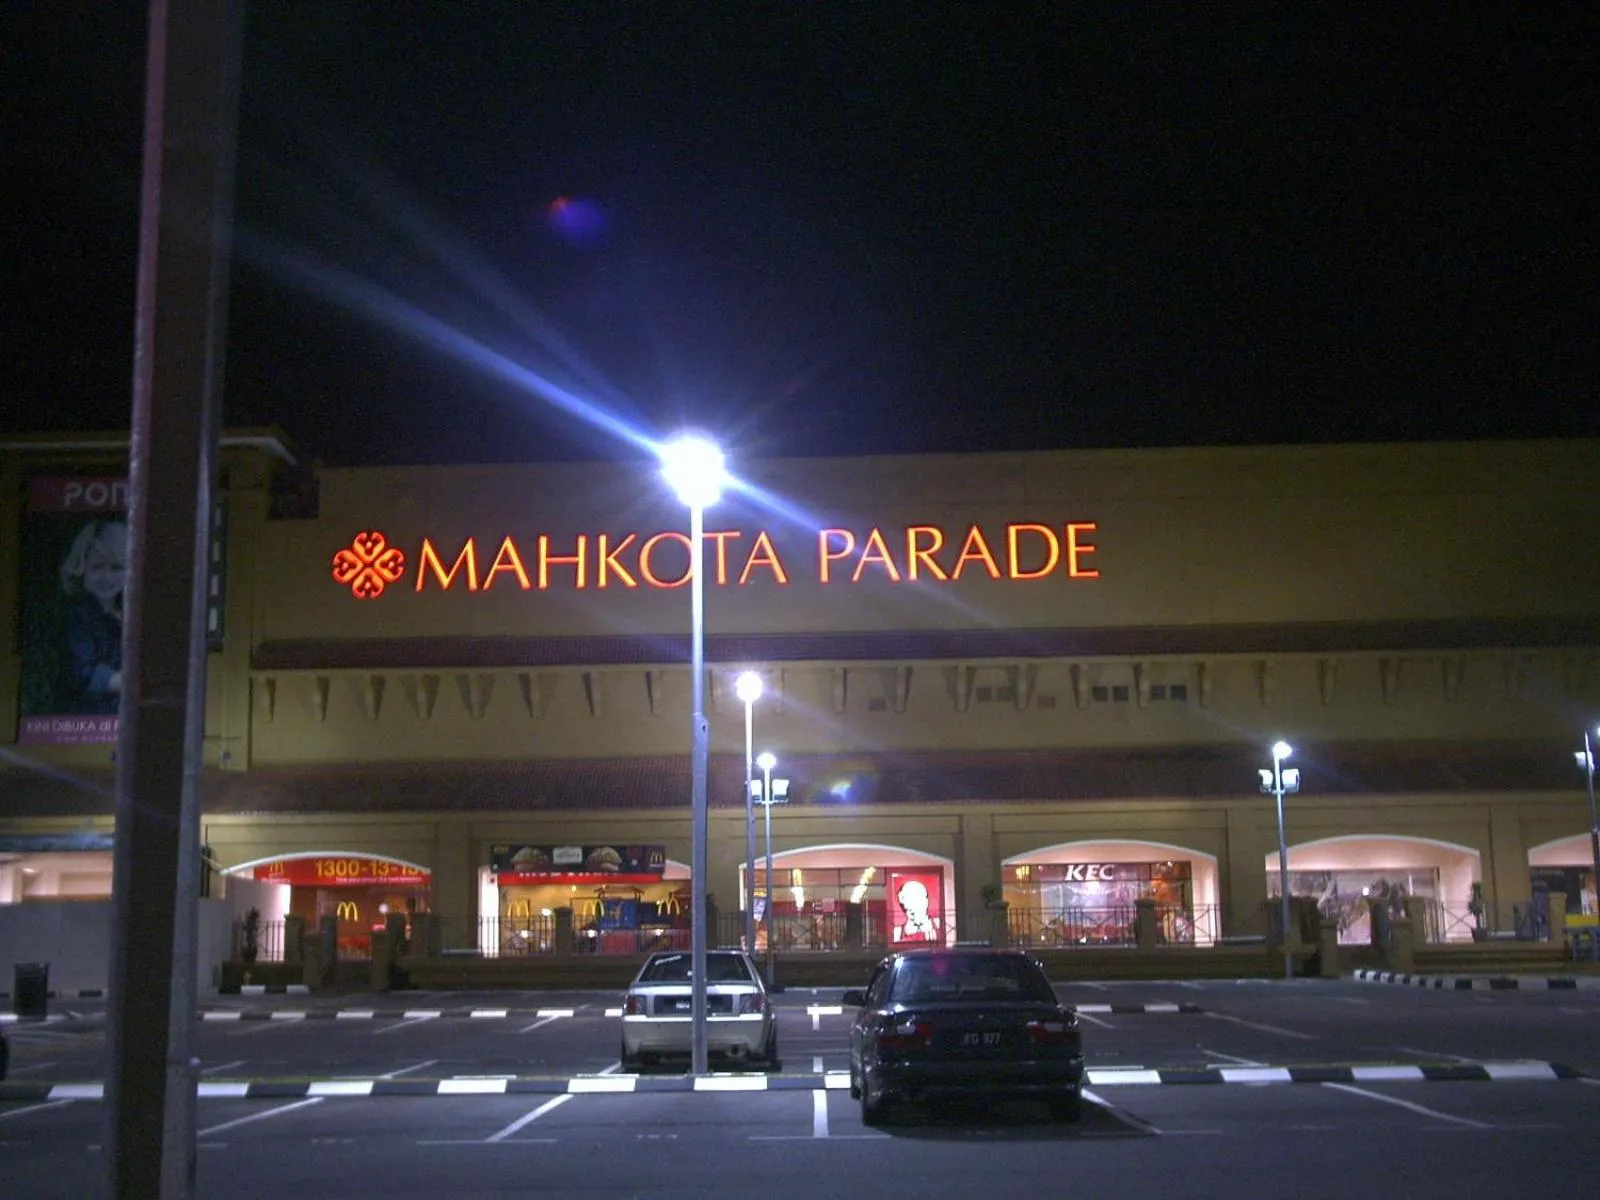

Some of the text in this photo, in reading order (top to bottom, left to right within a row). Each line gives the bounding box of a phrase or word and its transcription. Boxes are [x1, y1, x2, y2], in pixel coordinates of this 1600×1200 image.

[414, 522, 1101, 591] MAHKOTA PARADE
[1064, 864, 1115, 881] KFC
